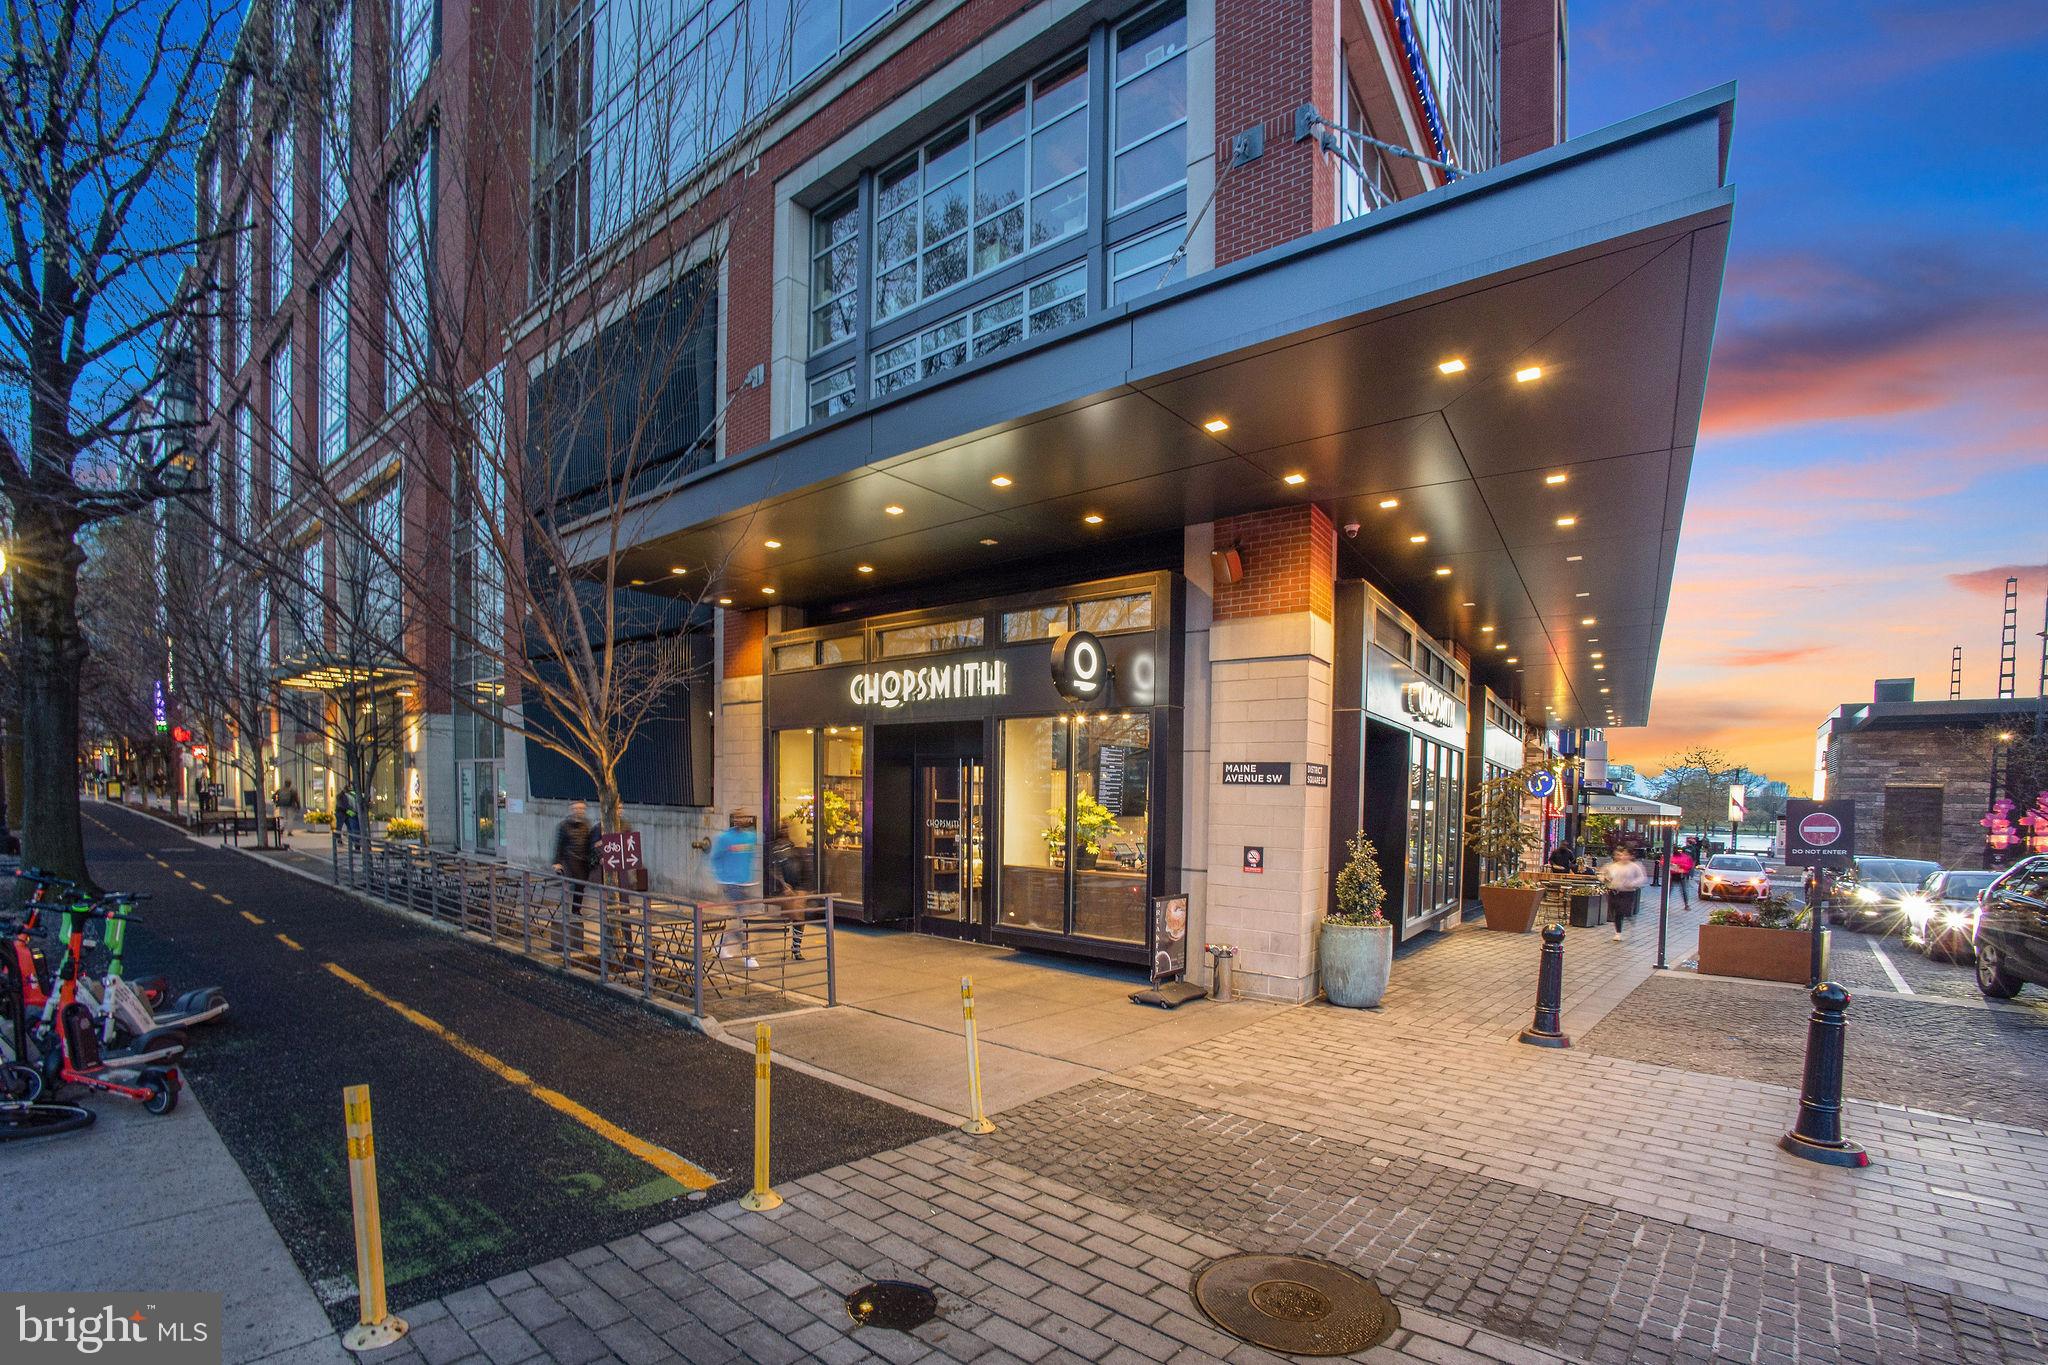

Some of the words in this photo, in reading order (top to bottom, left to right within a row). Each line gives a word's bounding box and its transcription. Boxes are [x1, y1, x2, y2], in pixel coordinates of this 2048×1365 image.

[850, 660, 1001, 708] CHOPSMITH
[1225, 764, 1257, 773] MAINE
[1225, 774, 1264, 783] AVENUE
[1266, 774, 1283, 783] SW
